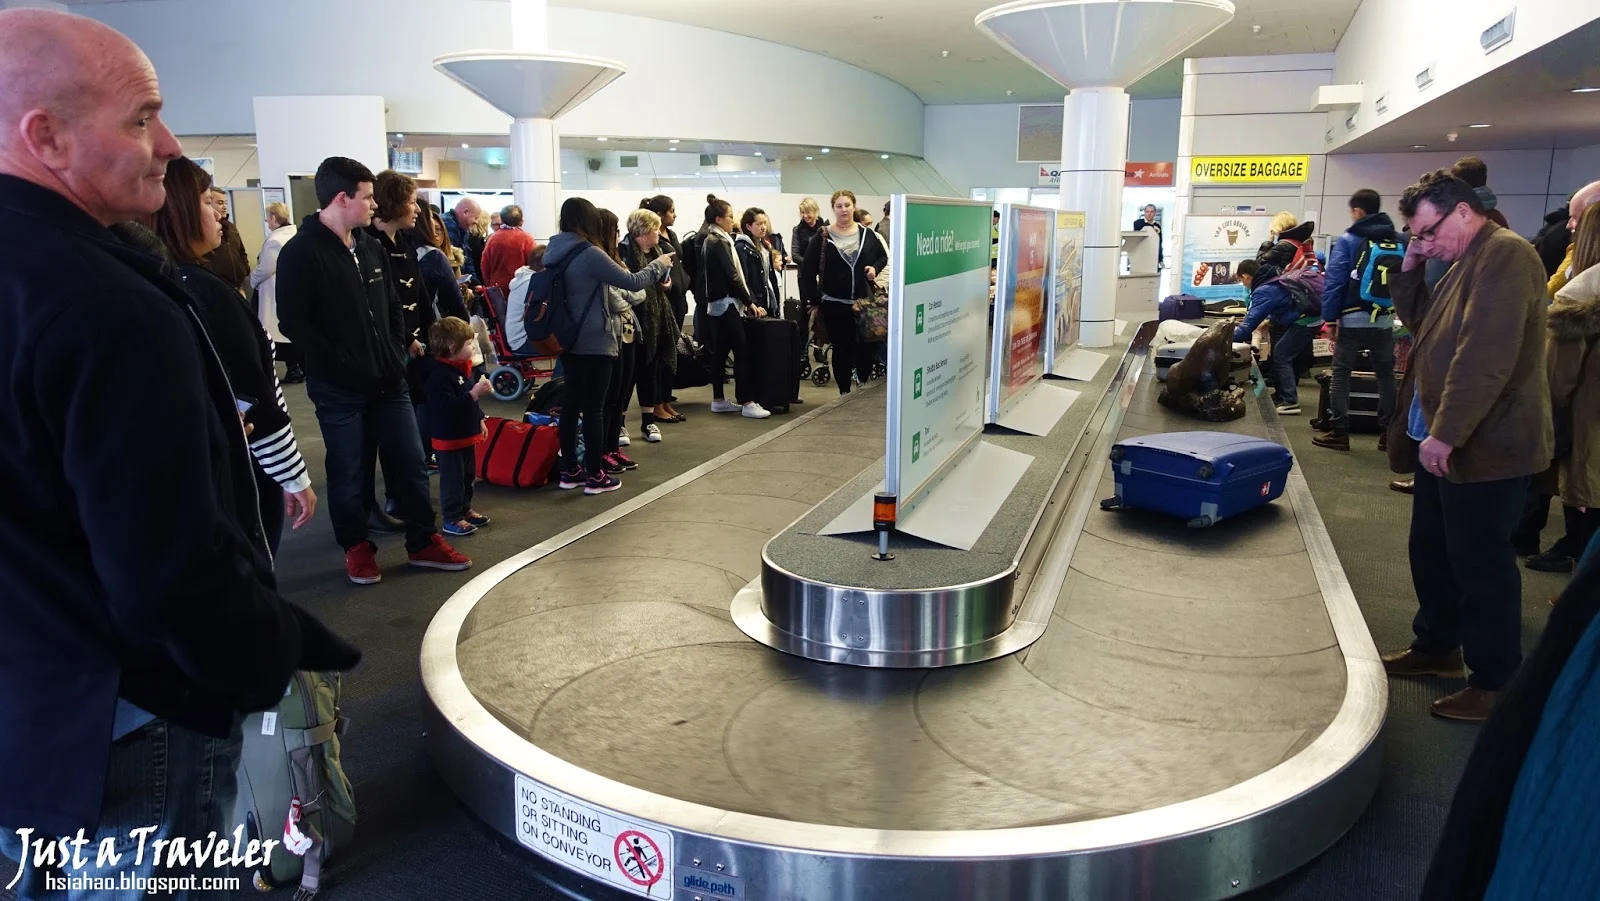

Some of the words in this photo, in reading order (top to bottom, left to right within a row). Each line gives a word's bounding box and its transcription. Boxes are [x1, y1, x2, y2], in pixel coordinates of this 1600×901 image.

[1195, 163, 1247, 177] OVERSIZE
[1250, 162, 1303, 177] BAGGAGE
[916, 231, 934, 257] Need
[935, 236, 940, 254] a
[940, 229, 954, 253] ride?
[521, 786, 537, 805] NO
[541, 797, 601, 833] STANDING
[522, 804, 538, 822] OR
[541, 814, 588, 845] SITTING
[522, 821, 538, 839] ON
[542, 831, 611, 872] CONVEYOR
